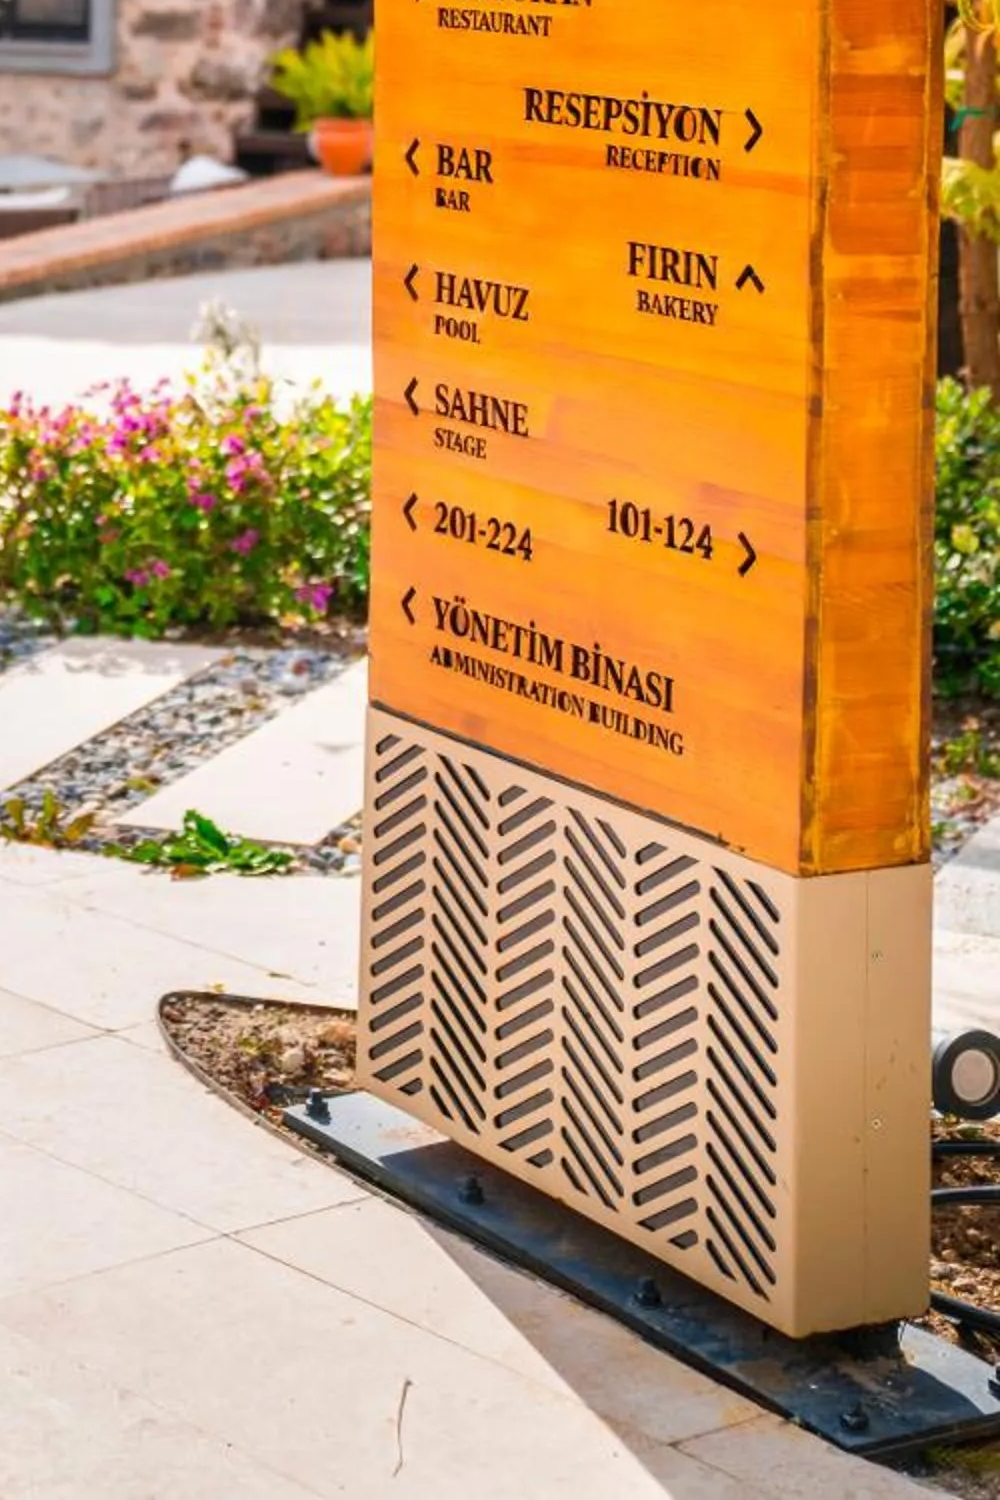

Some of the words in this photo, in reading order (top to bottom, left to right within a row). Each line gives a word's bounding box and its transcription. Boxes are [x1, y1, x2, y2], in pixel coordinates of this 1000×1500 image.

[439, 8, 552, 36] RESTAURANT
[524, 87, 722, 145] RESEPSİYON
[438, 144, 493, 183] BAR
[606, 145, 721, 181] RECEPTION
[436, 188, 469, 211] BAR
[628, 241, 718, 289] FIRIN
[436, 272, 528, 321] HAVUZ
[637, 290, 718, 325] BAKERY
[435, 315, 480, 343] POOL
[435, 384, 528, 437] SAHNE
[435, 428, 486, 459] STAGE
[434, 502, 532, 561] 201-224
[608, 499, 713, 559] 101-124
[432, 596, 563, 672] YÖNETİM
[570, 643, 674, 712] BİNASI
[430, 645, 583, 716] ADMINISTRATION
[588, 701, 684, 755] BUILDING
